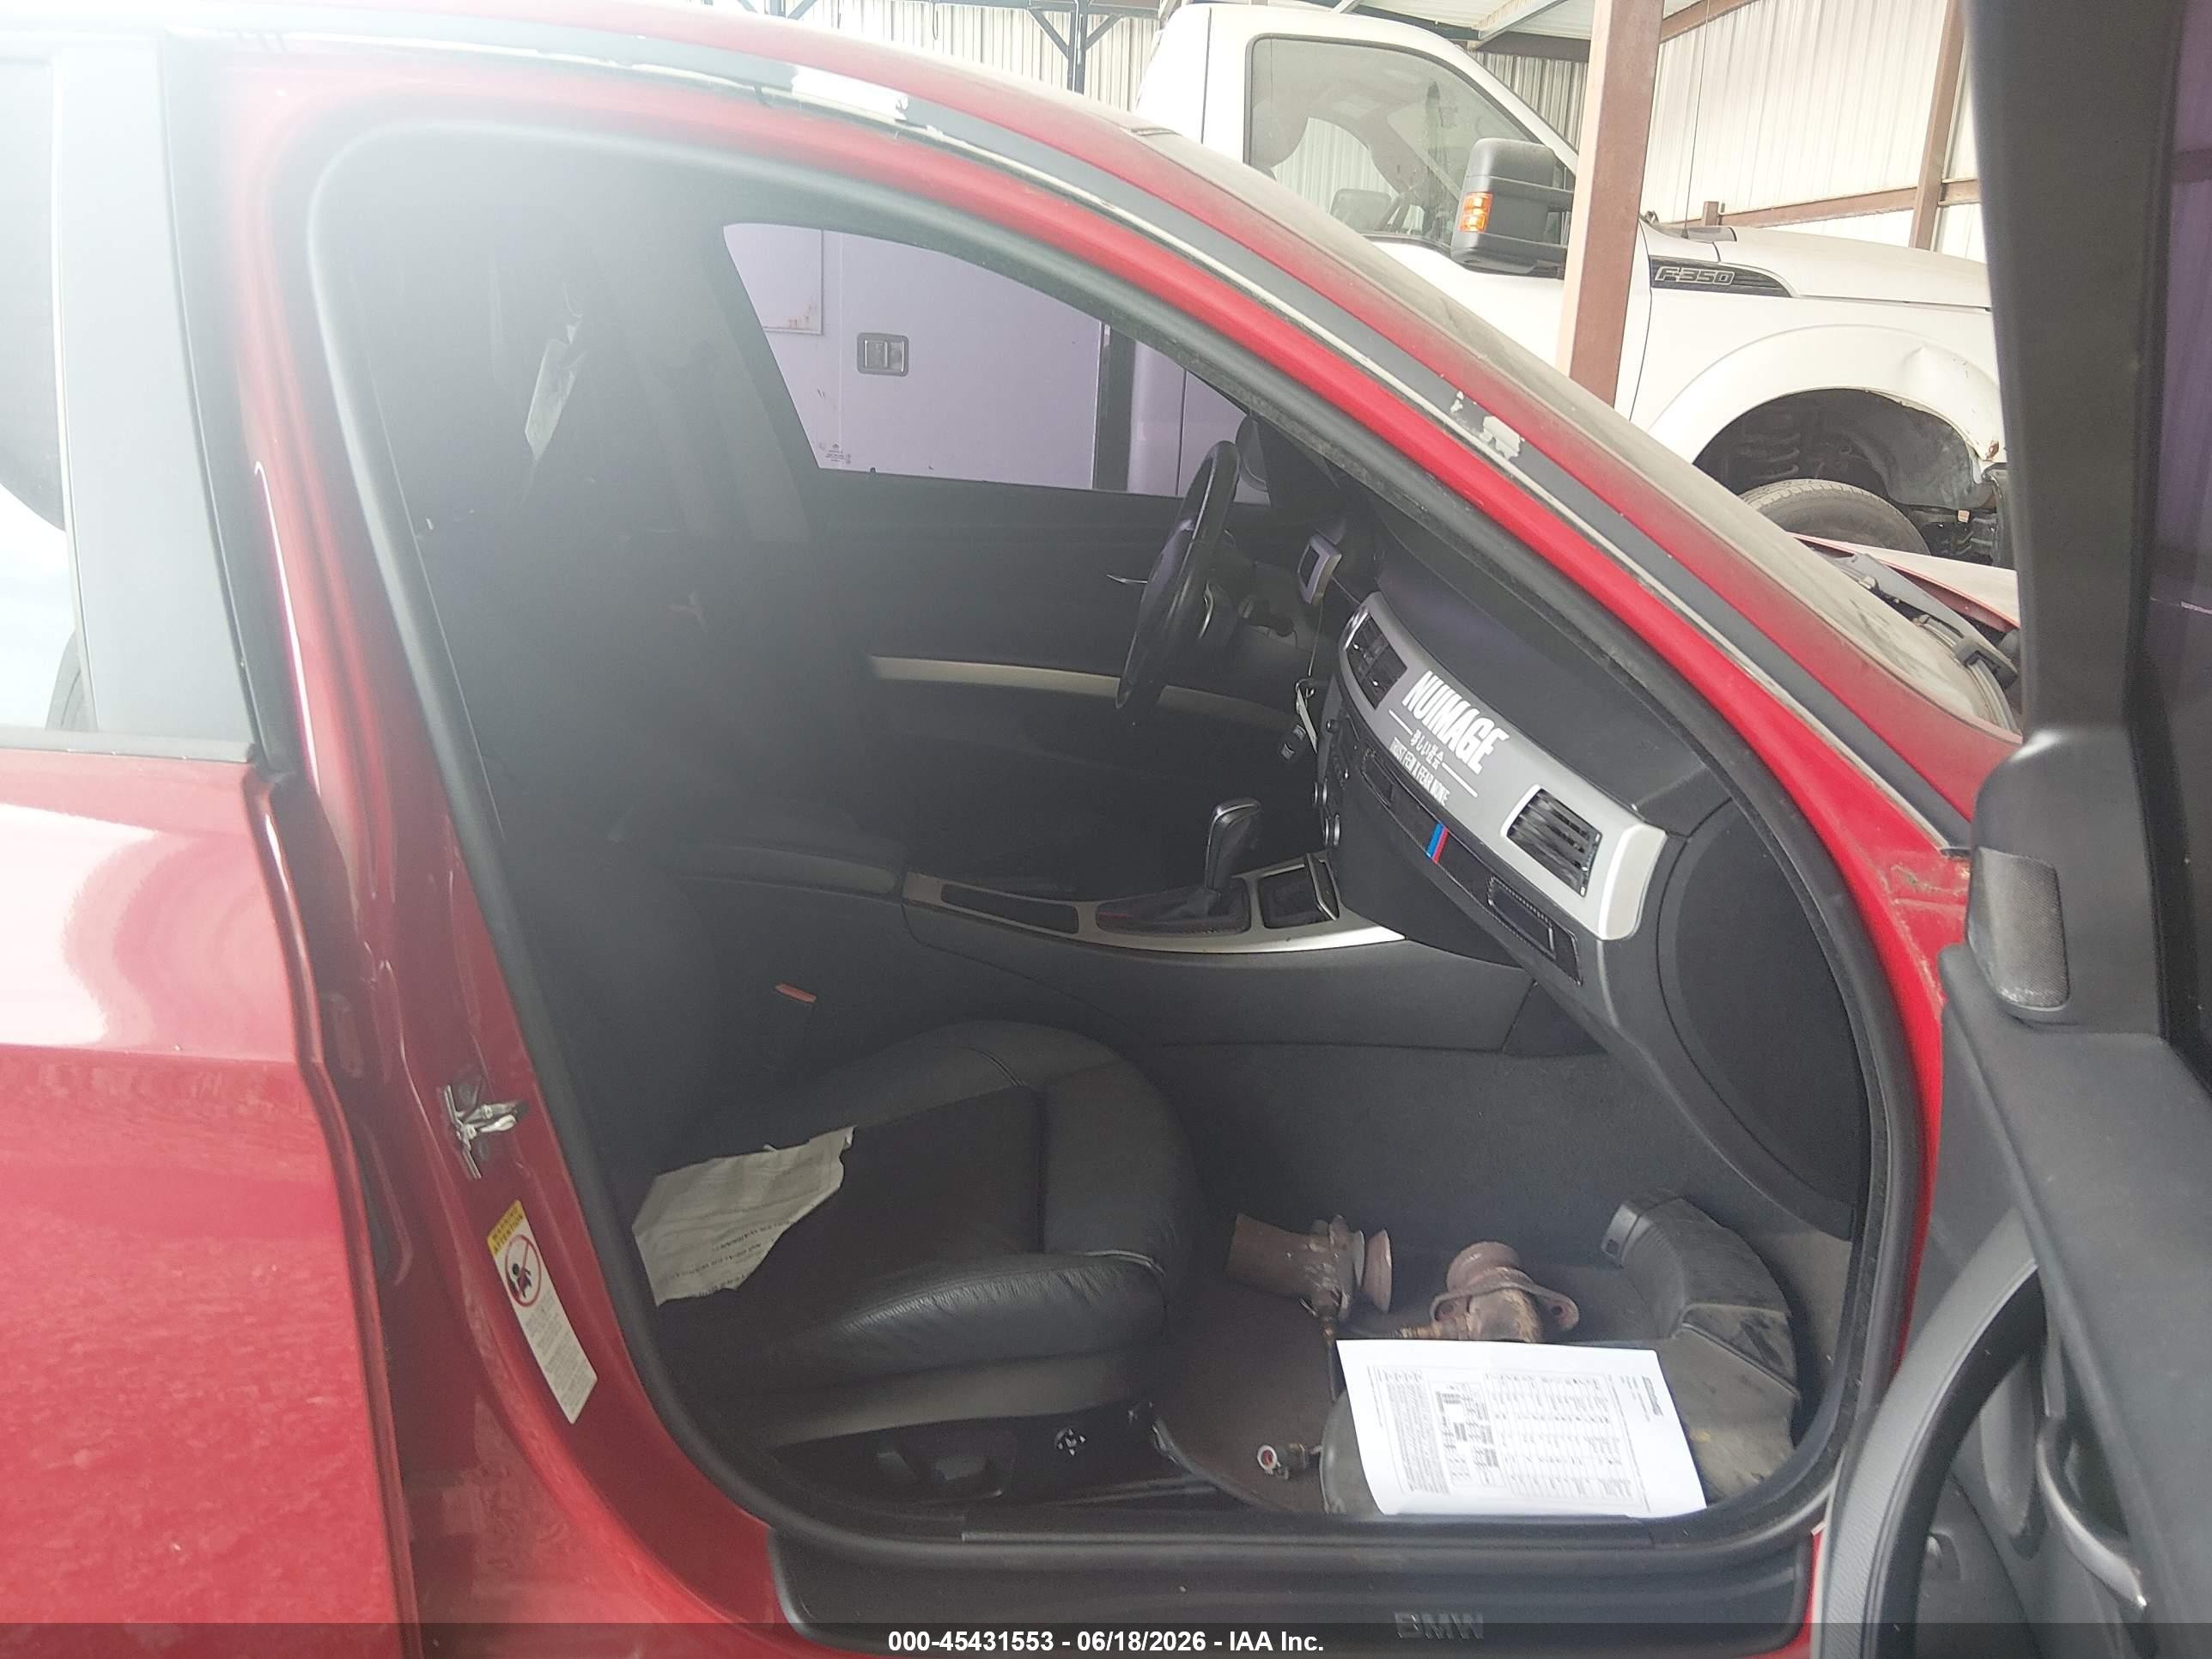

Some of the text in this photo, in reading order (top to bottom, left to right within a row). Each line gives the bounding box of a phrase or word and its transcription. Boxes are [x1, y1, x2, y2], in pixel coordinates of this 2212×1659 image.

[1654, 265, 1735, 286] F-350
[1401, 670, 1510, 775] NUIMAGE
[1394, 1612, 1485, 1640] BMW
